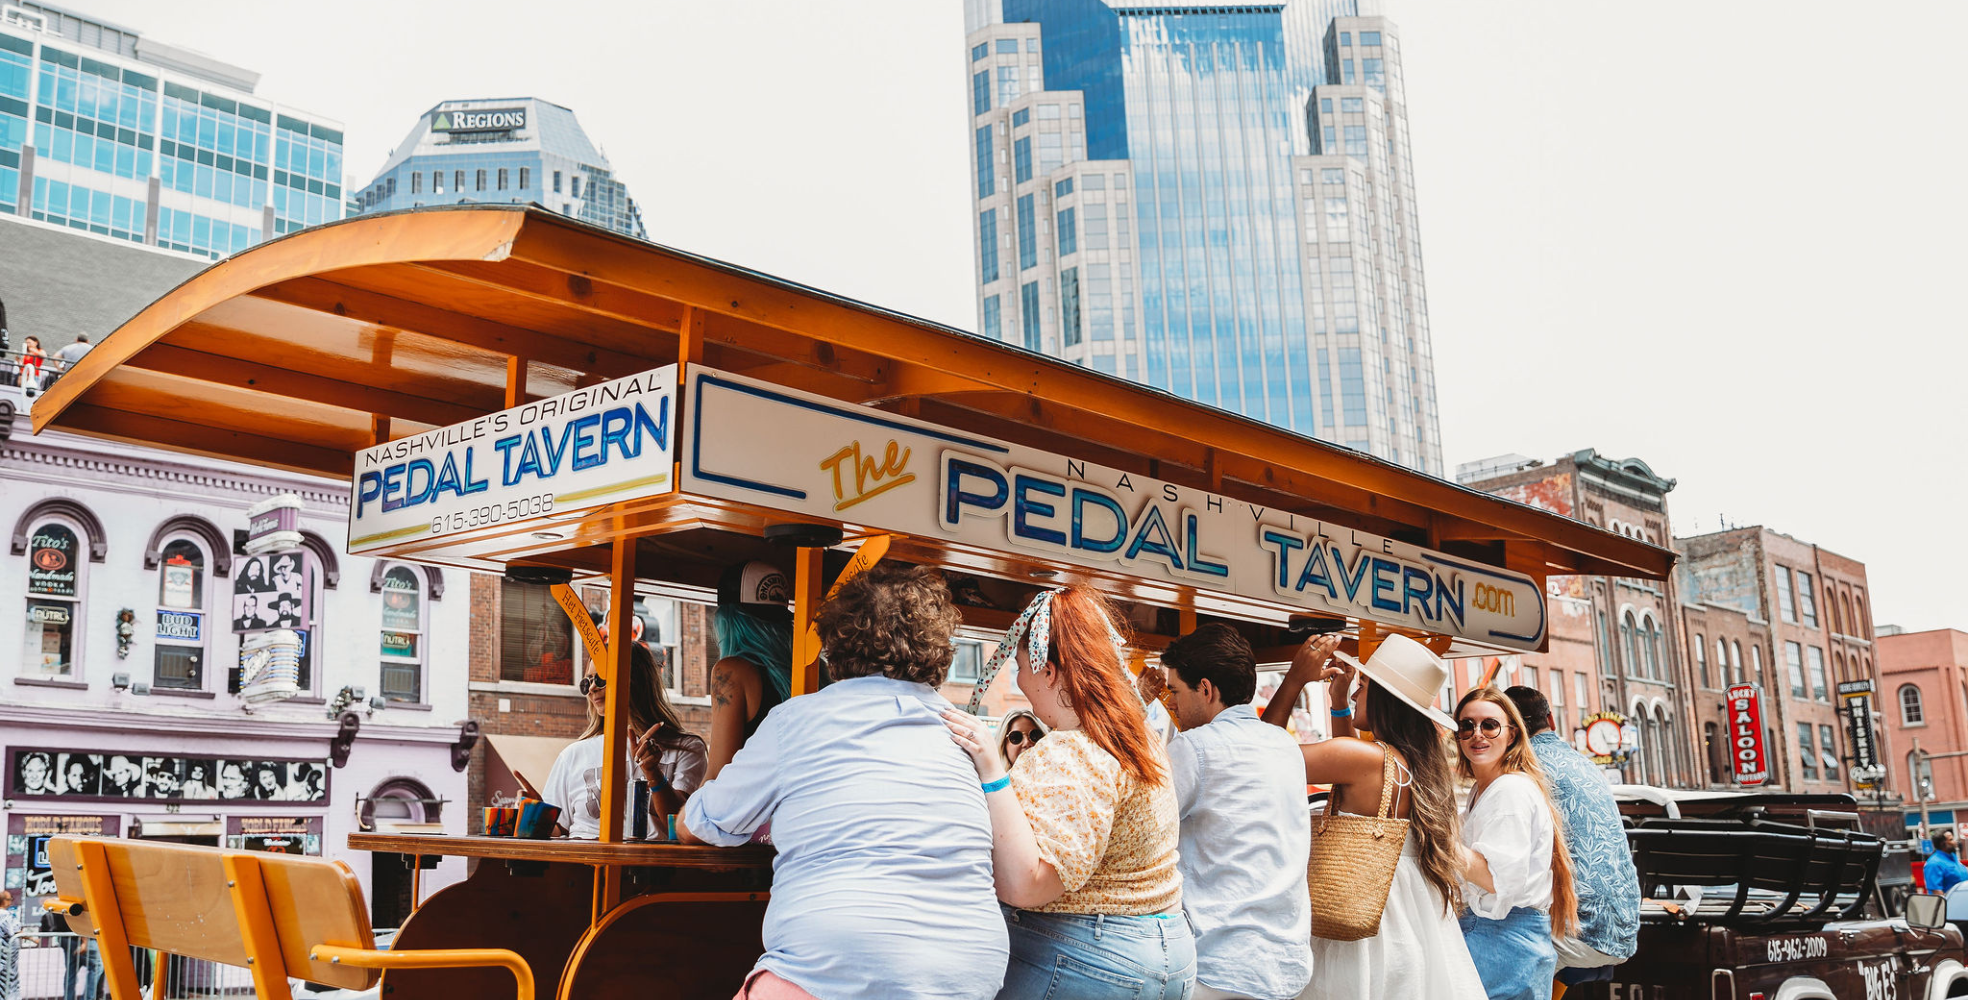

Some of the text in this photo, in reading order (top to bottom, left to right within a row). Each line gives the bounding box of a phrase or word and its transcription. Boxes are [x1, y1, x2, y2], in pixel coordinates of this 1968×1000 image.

[365, 374, 662, 467] NASHVILLE'S ORIGINAL
[356, 395, 669, 519] PEDAL TAVERN
[820, 439, 911, 500] The
[431, 493, 554, 534] 615-390-5038
[1067, 460, 1393, 554] NASHVILLE
[31, 535, 70, 549] Tito's
[946, 458, 1229, 578] PEDAL
[1264, 530, 1465, 628] TAVERN
[157, 623, 198, 637] LIGHT
[161, 613, 193, 626] BUD
[562, 590, 601, 655] Het Fietscafe
[1734, 699, 1757, 774] SALOON
[1850, 696, 1870, 769] WHISKEY
[1767, 936, 1828, 962] 615-962-2009
